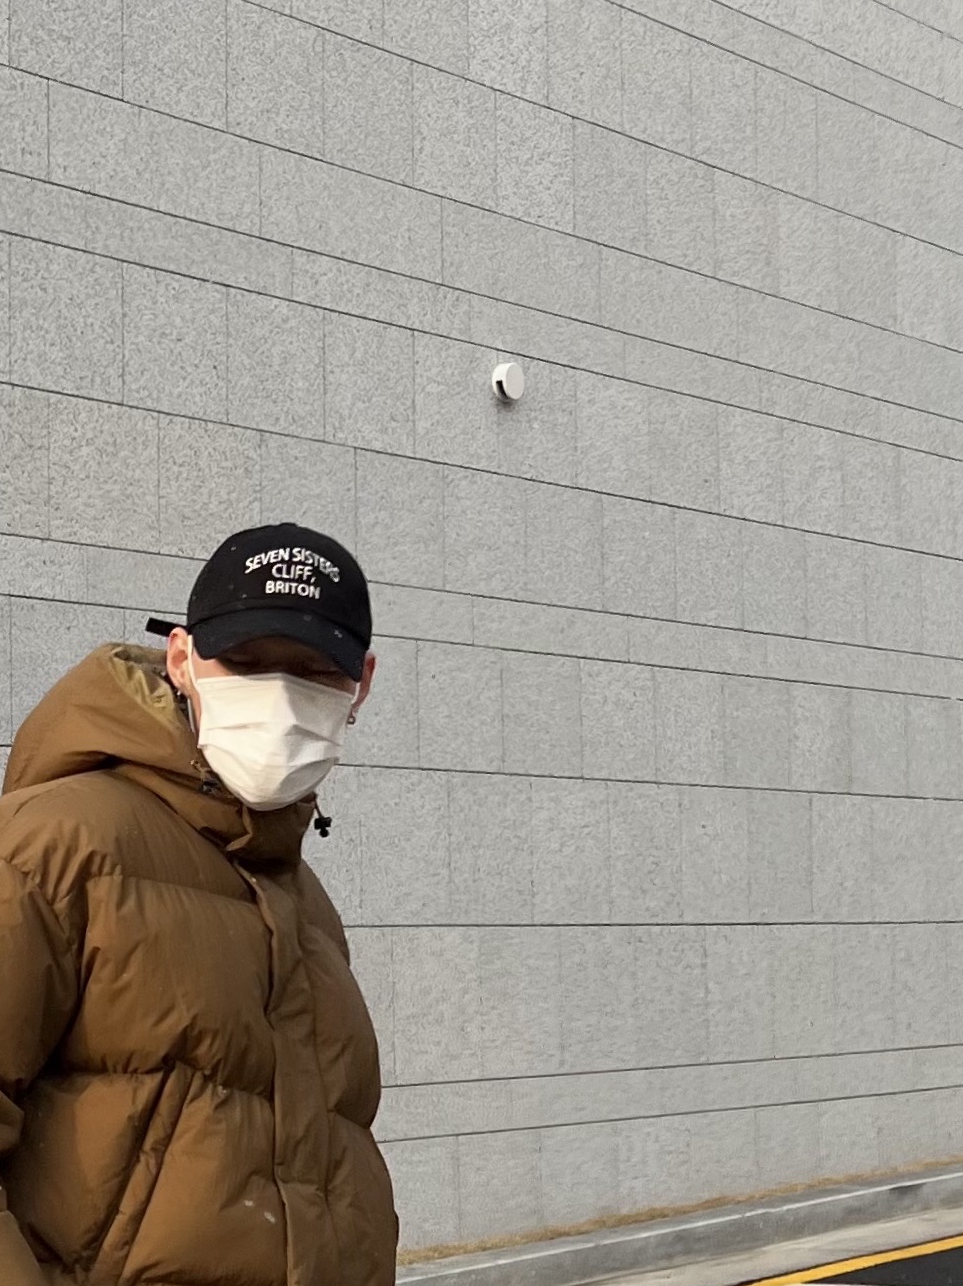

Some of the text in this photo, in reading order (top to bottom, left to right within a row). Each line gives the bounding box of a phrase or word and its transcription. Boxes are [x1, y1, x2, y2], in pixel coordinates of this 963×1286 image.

[244, 547, 340, 582] SEVEN SISTERS
[271, 563, 316, 583] CLIFF,
[265, 580, 321, 599] BRITON
